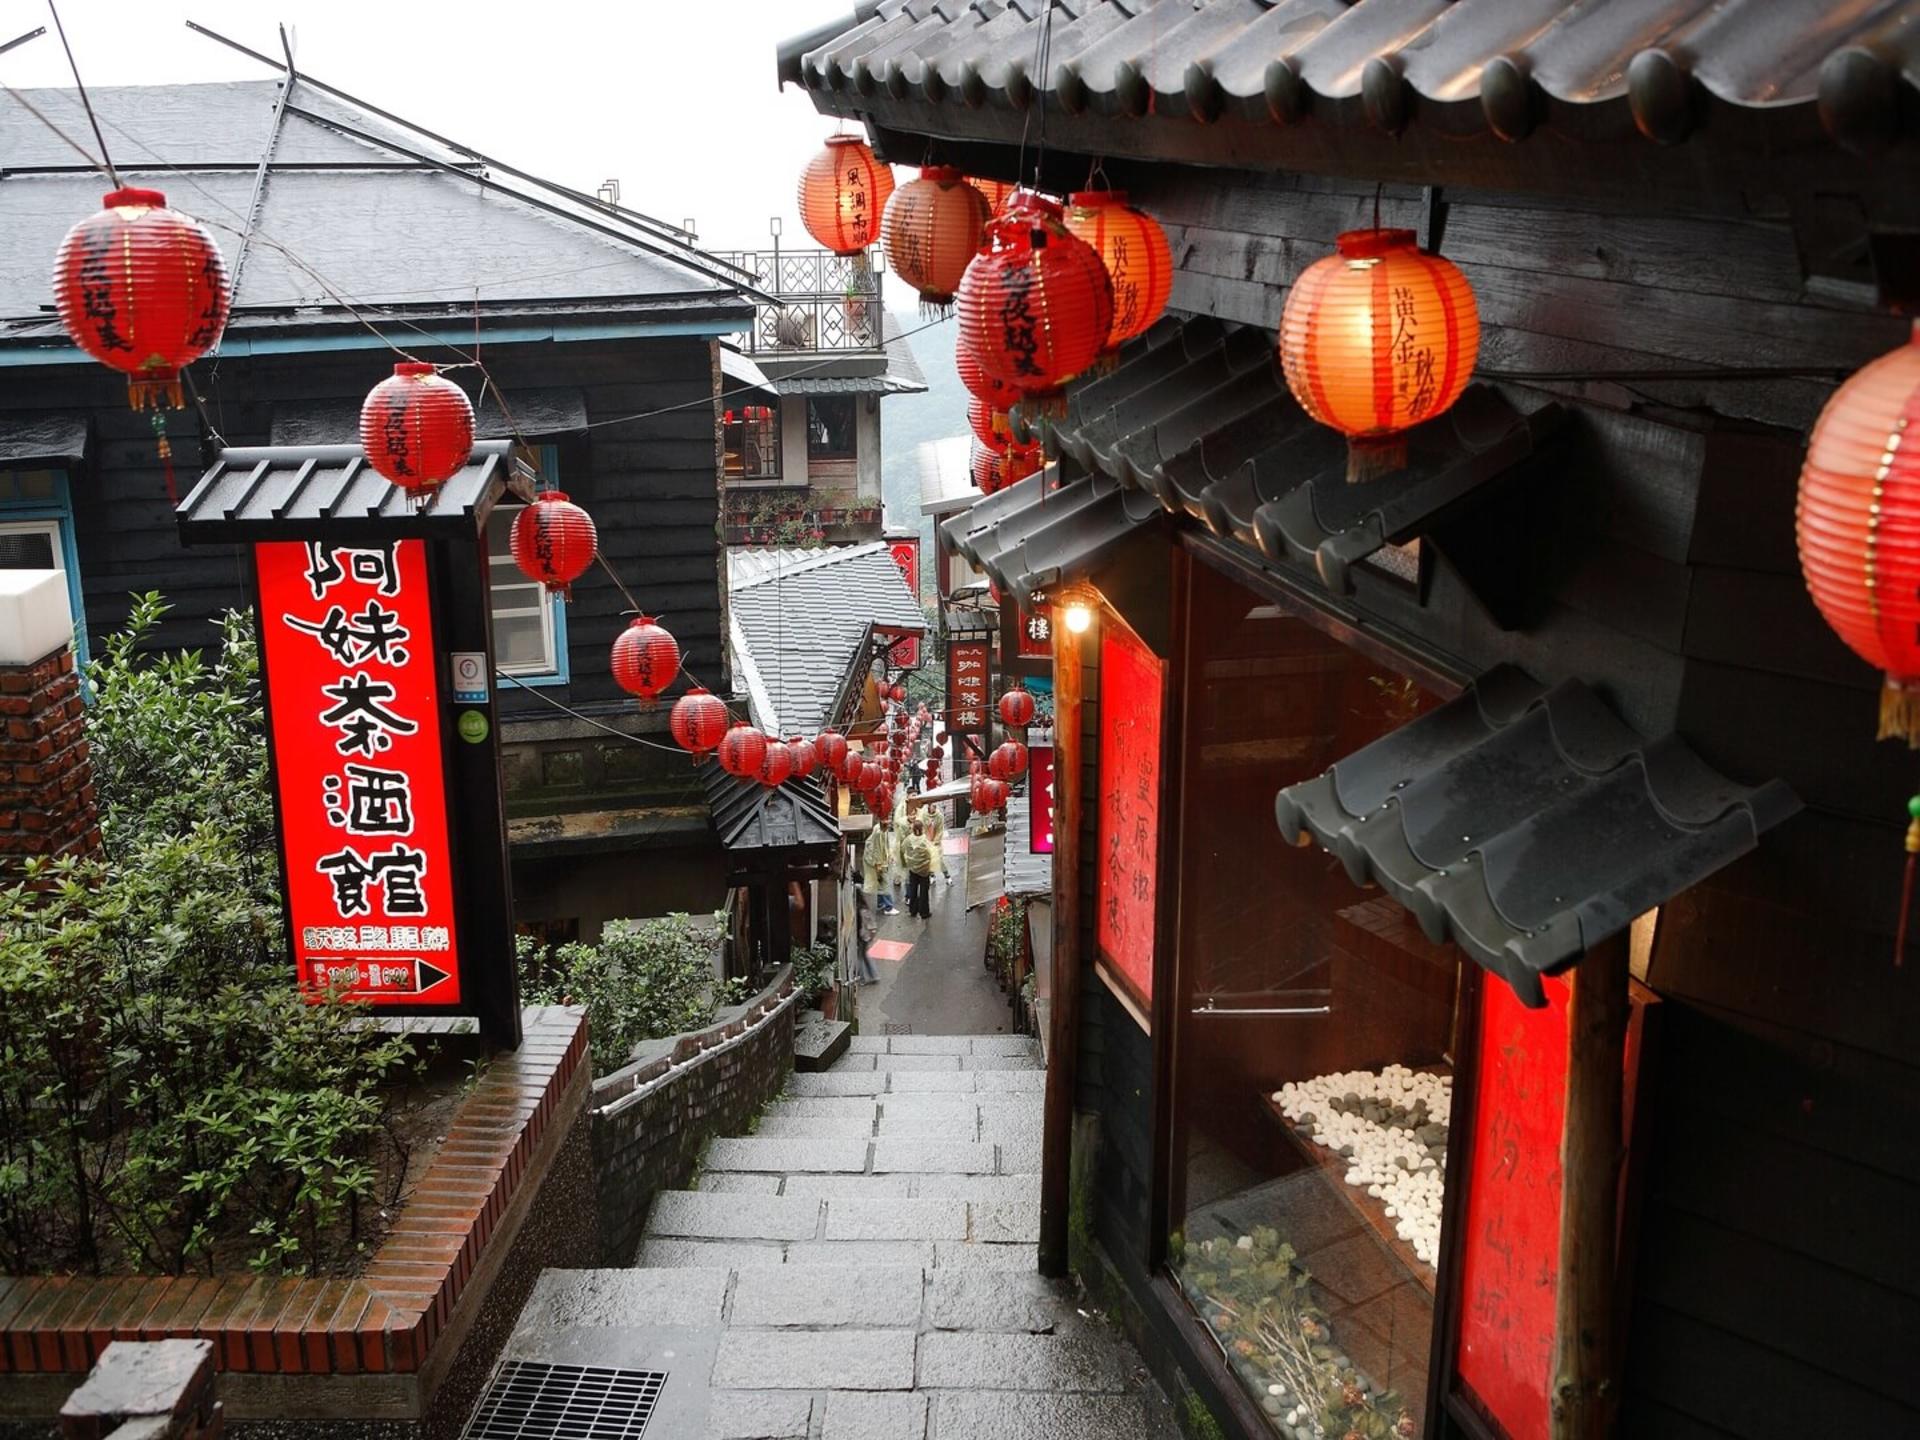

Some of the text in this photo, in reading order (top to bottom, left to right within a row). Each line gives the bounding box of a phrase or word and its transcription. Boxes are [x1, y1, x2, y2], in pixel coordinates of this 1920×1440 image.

[847, 168, 868, 244] 風調雨順
[1387, 286, 1418, 364] 黃金
[283, 539, 428, 918] 阿妹茶酒館
